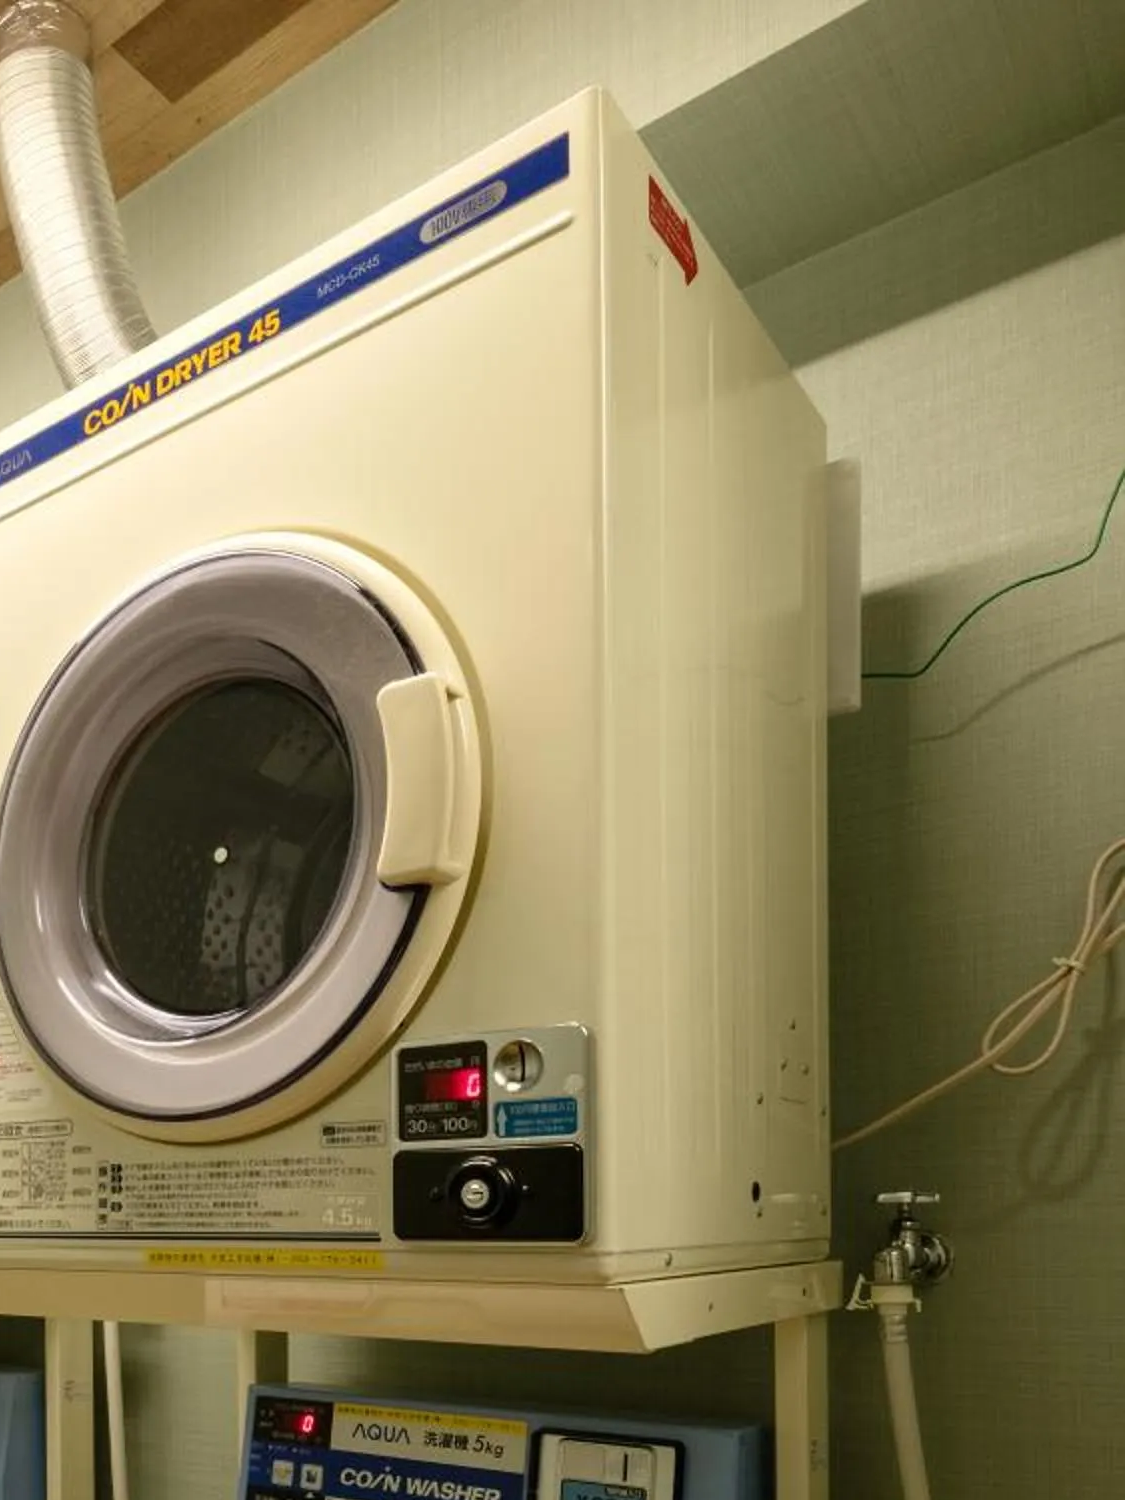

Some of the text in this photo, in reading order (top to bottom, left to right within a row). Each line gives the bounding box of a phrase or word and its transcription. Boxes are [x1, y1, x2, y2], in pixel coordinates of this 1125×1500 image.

[155, 331, 241, 396] DRYER
[248, 308, 281, 343] 45
[352, 1423, 505, 1458] AQUA 洗濯機 5kg
